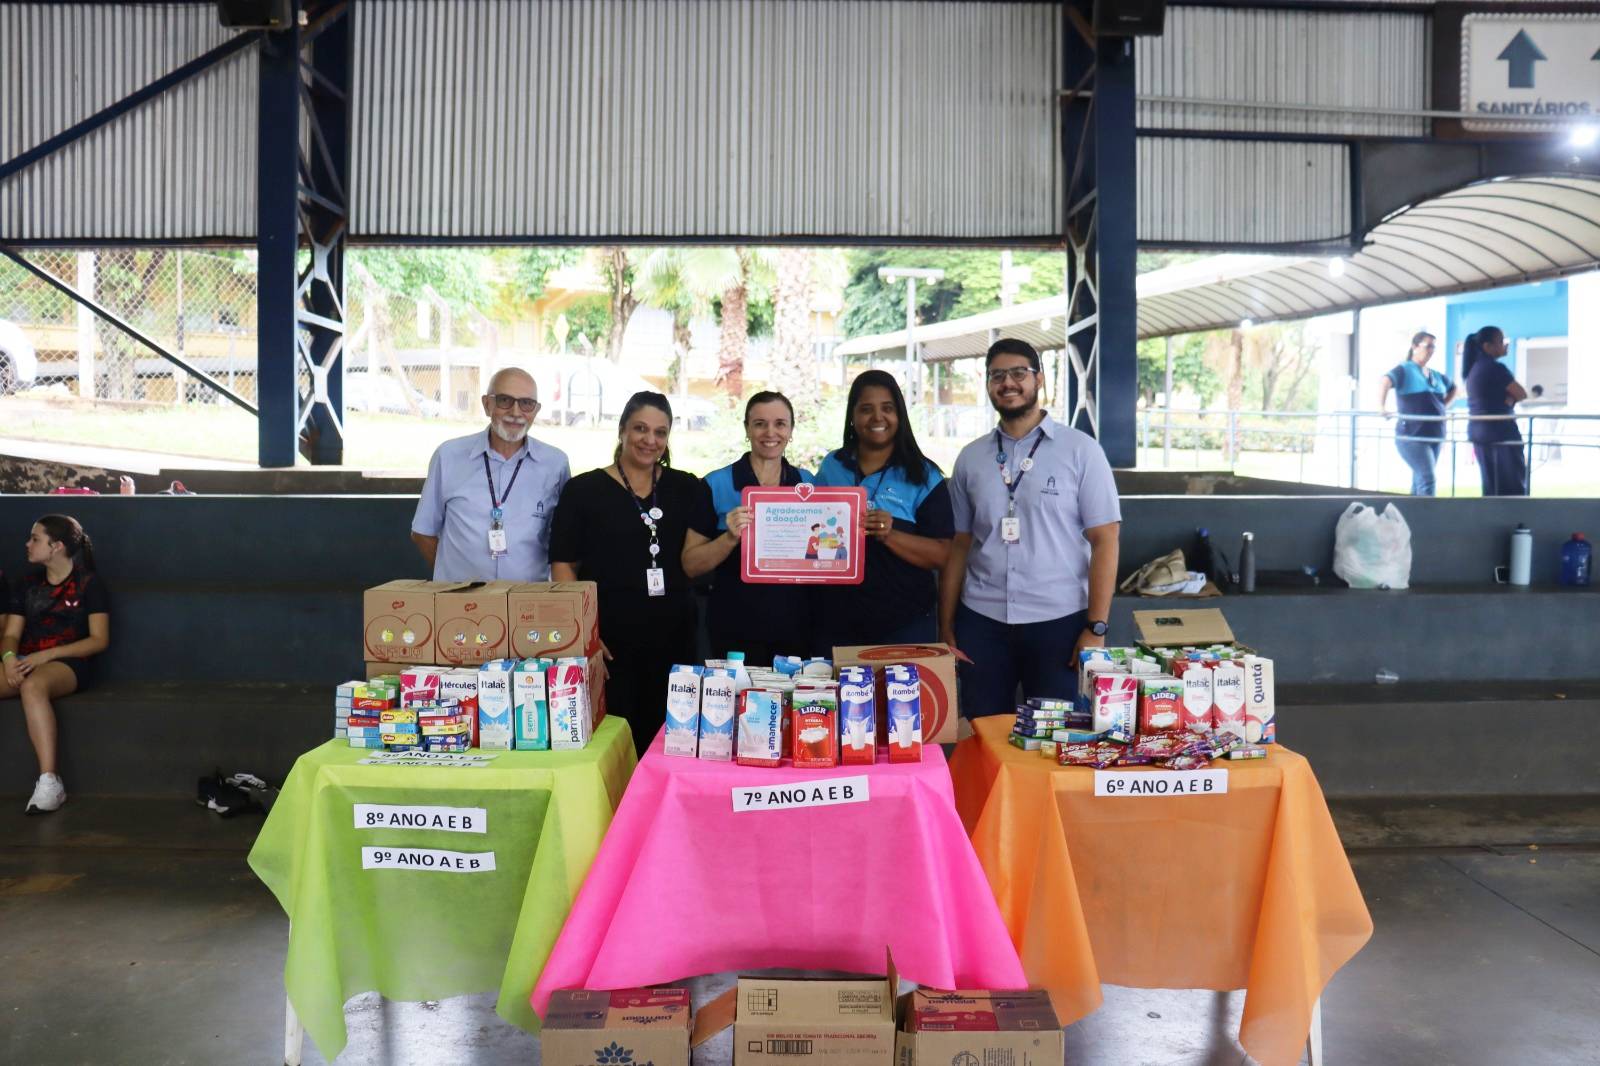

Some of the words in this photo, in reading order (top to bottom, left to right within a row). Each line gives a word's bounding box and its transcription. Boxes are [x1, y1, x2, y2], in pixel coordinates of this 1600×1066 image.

[1476, 97, 1591, 115] SANITÁRIOS
[766, 507, 823, 515] Agradecemos
[772, 515, 807, 523] doação!
[440, 681, 477, 690] Hércules
[481, 680, 506, 689] Italac
[1186, 679, 1210, 688] Italac
[1217, 678, 1240, 688] Italac
[1251, 663, 1265, 703] Quatá
[671, 683, 697, 694] Italac
[705, 688, 732, 698] Italac
[1152, 692, 1176, 700] LIDER
[800, 706, 827, 715] LIDER
[526, 711, 535, 733] semi
[568, 697, 581, 743] parmalat
[768, 700, 778, 751] amanhecer
[1140, 734, 1168, 743] Royal
[402, 751, 439, 759] ANO
[1106, 779, 1125, 793] 6º
[1129, 779, 1168, 794] ANO
[1173, 779, 1184, 793] A
[1189, 779, 1198, 792] E
[1203, 778, 1213, 792] B
[743, 791, 763, 806] 7º
[767, 788, 807, 805] ANO
[811, 787, 825, 801] A
[828, 786, 838, 800] E
[843, 785, 854, 799] B
[366, 812, 385, 825] 8º
[389, 813, 427, 827] ANO
[432, 814, 444, 828] A
[448, 815, 457, 829] E
[462, 816, 473, 829] B
[373, 851, 392, 863] 9º
[397, 852, 435, 866] ANO
[439, 856, 451, 868] A
[455, 858, 465, 869] E
[469, 859, 481, 869] B
